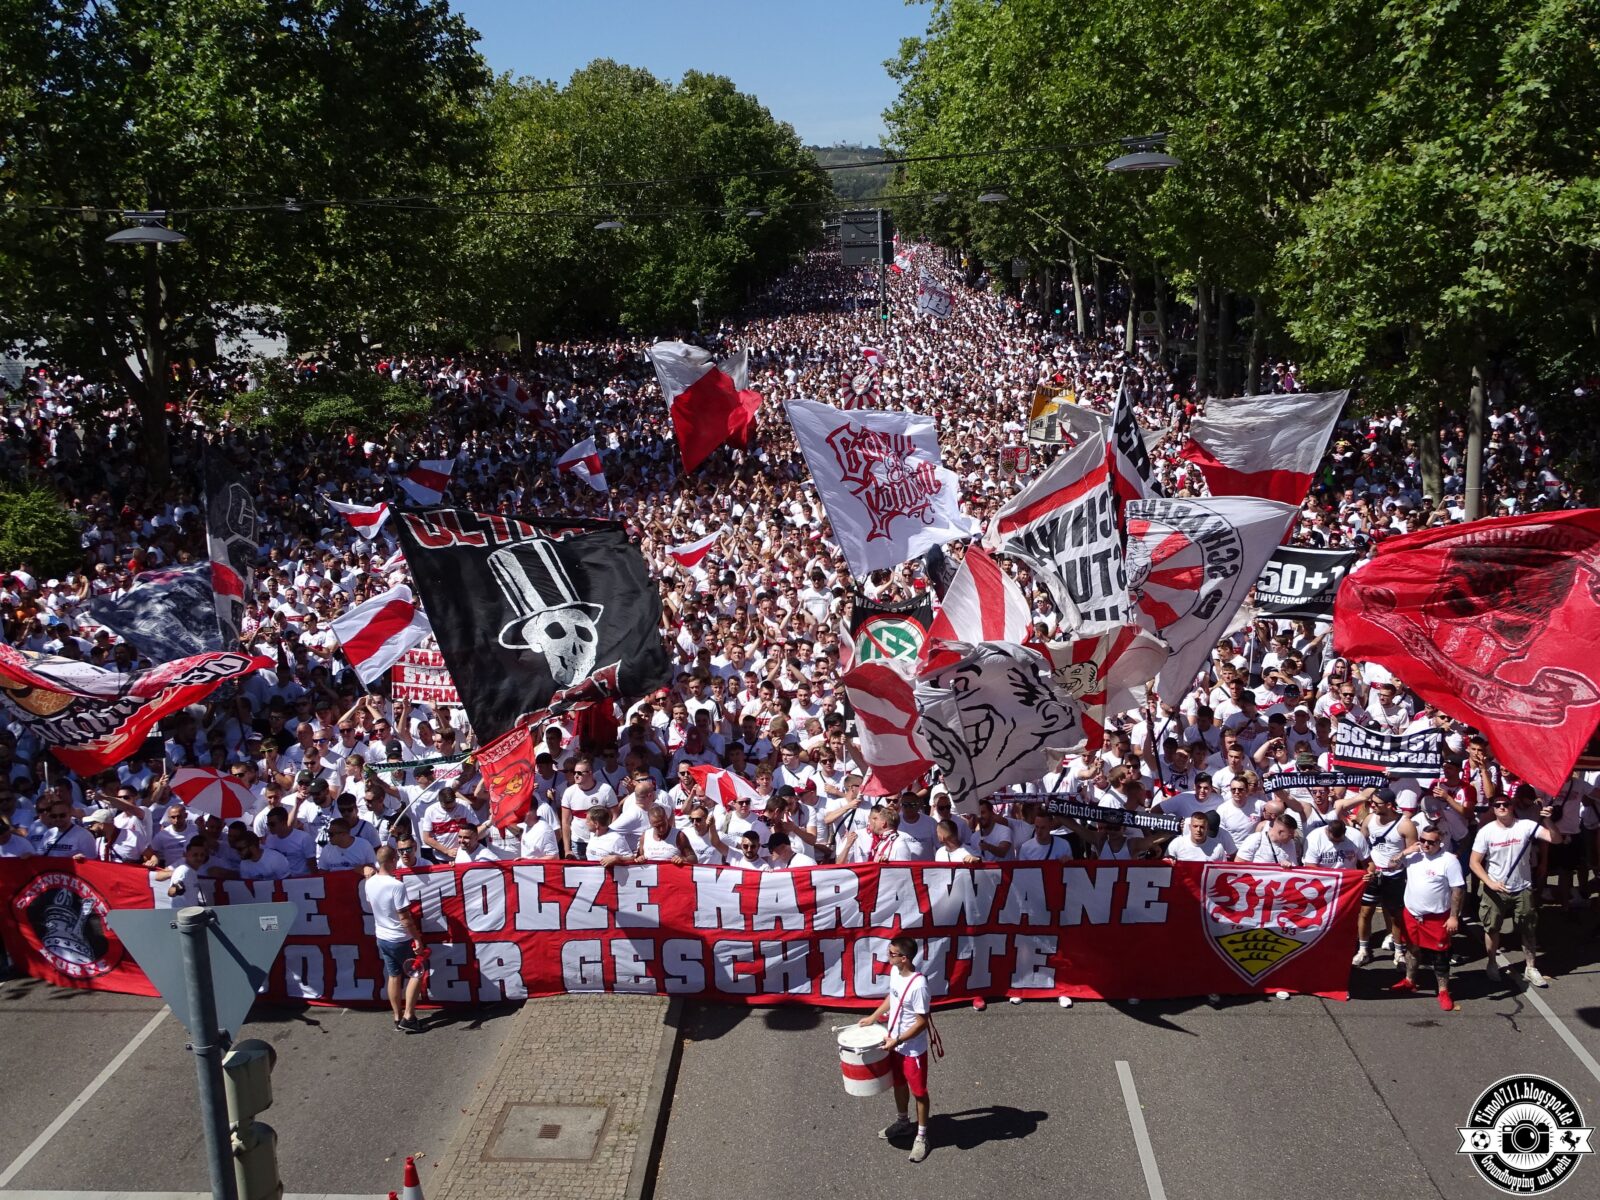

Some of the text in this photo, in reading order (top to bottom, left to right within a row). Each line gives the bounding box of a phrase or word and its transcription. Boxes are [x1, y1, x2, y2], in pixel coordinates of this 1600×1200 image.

[1257, 560, 1345, 596] 50+1
[393, 685, 462, 702] INTERN
[1336, 722, 1391, 751] 50+1
[1048, 799, 1103, 820] Schwaben
[358, 864, 660, 937] TOLZE
[693, 864, 1173, 932] KARAWANE
[258, 940, 529, 1002] OLER
